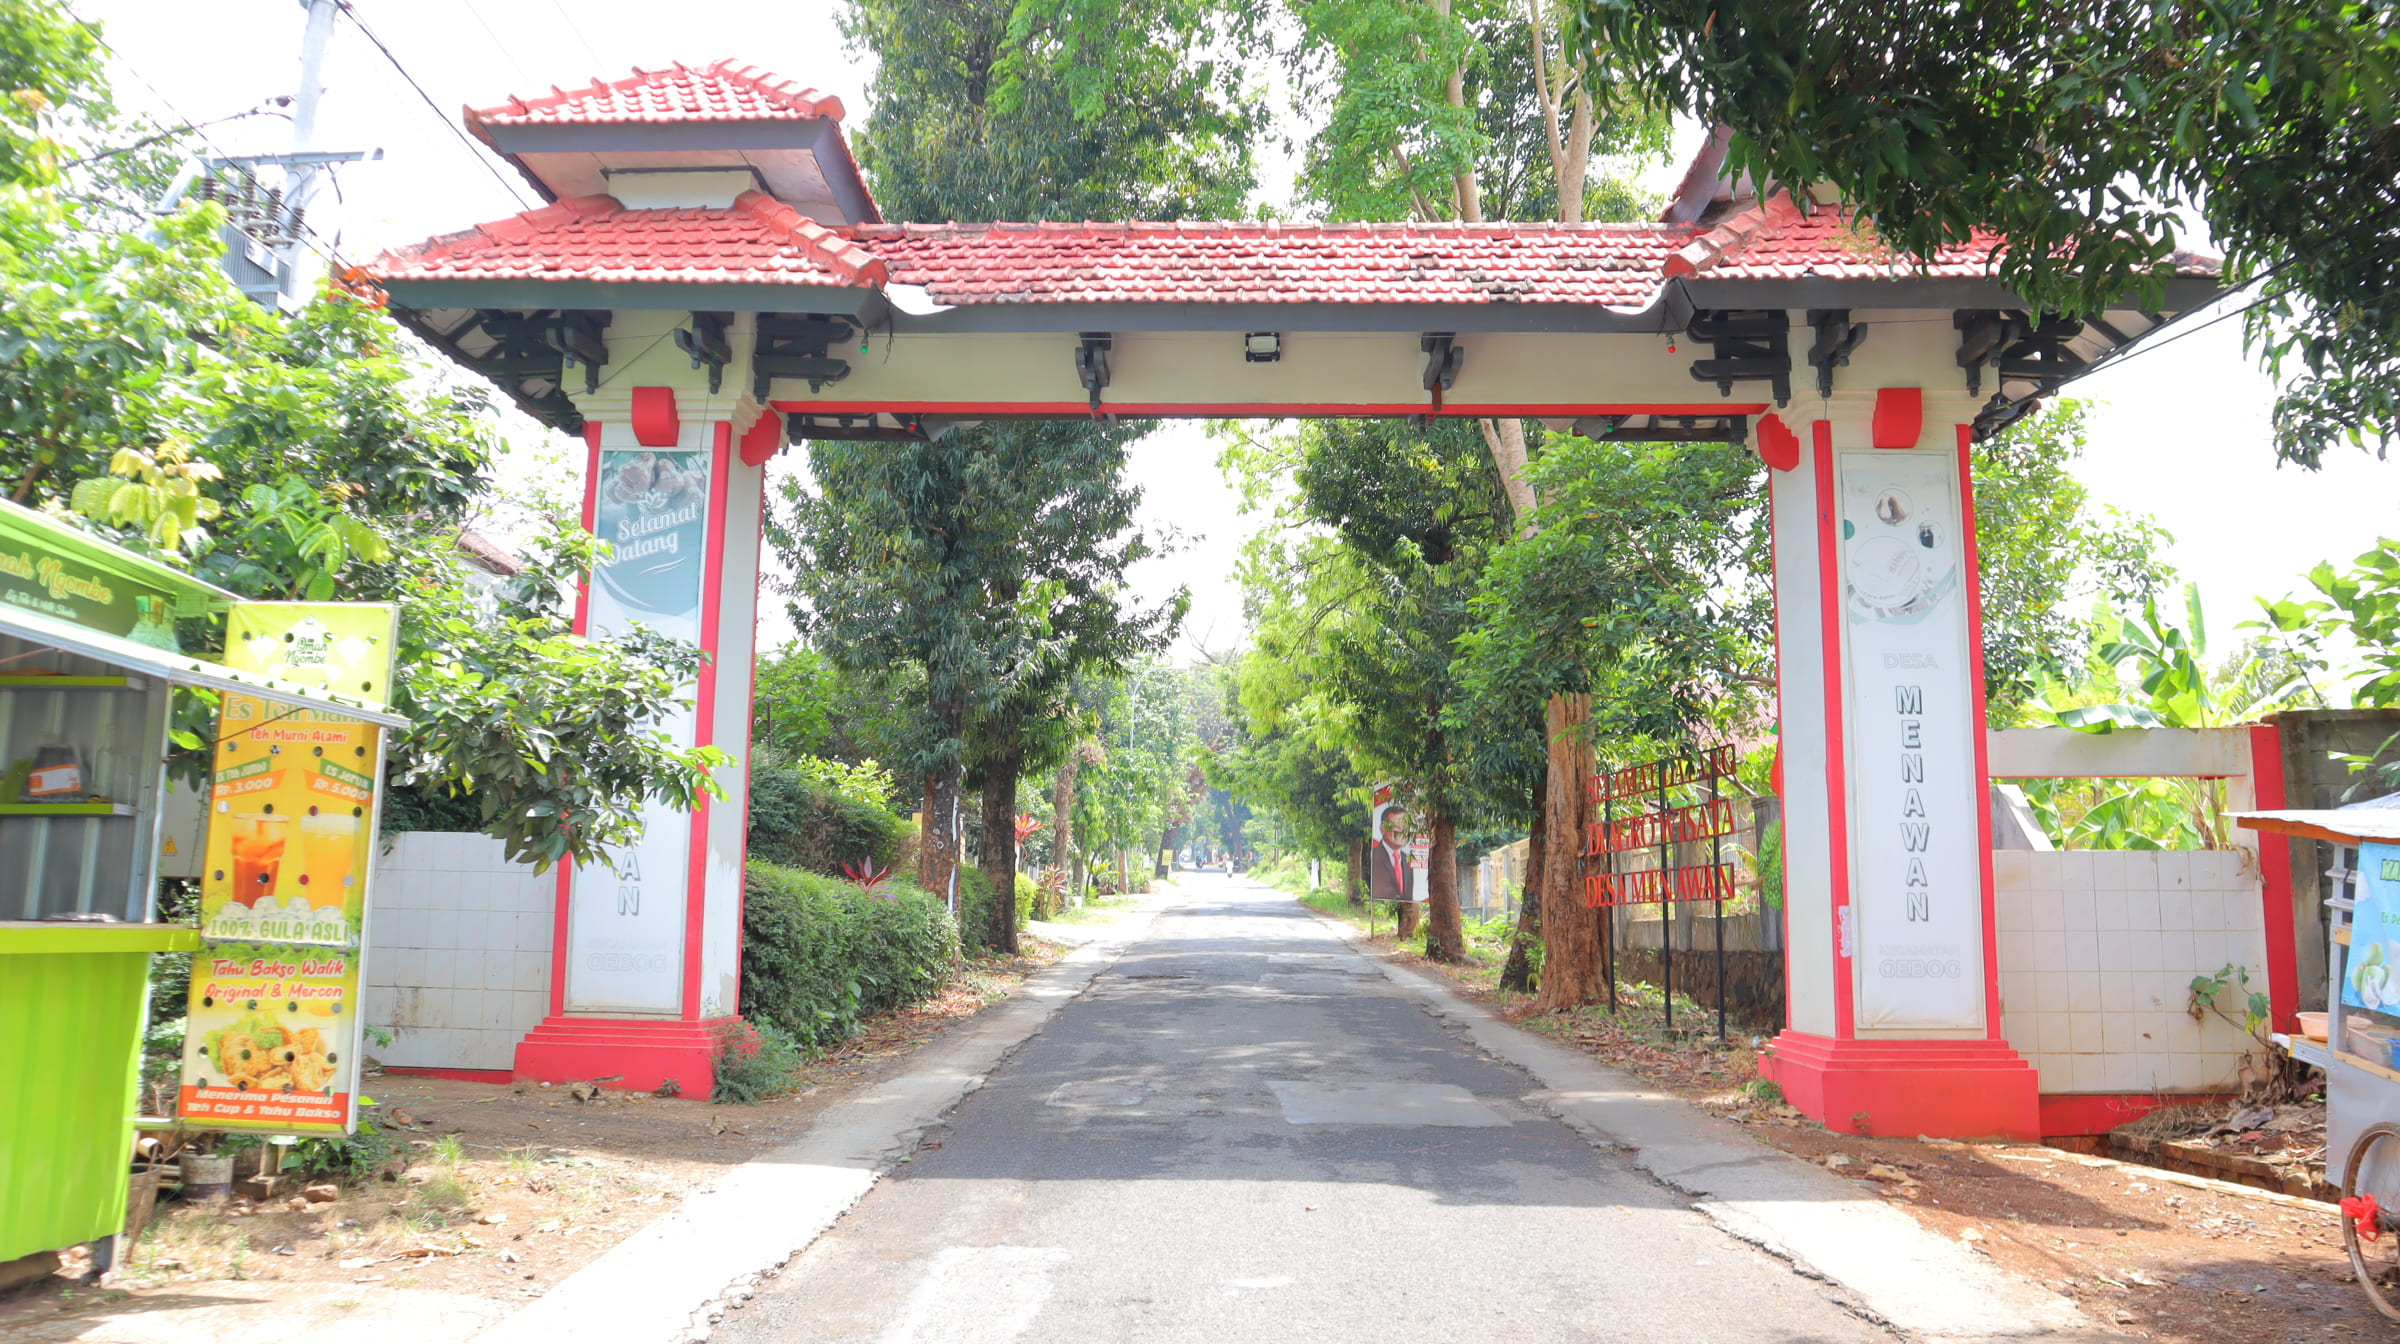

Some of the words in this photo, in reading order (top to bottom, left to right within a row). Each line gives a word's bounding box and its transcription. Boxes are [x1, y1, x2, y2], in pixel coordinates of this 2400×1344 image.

[616, 502, 697, 542] Selamat
[36, 556, 114, 605] Ngombe
[1883, 652, 1939, 670] DESA
[224, 696, 252, 720] Es
[250, 727, 270, 741] Teh
[273, 728, 309, 742] Murni
[1896, 685, 1930, 922] MENAWAN
[1586, 872, 1628, 909] DESA
[210, 920, 253, 937] 100%
[259, 920, 304, 940] GULA
[311, 921, 349, 942] ASLI
[212, 959, 246, 977] Tahu
[250, 958, 296, 979] Bakso
[302, 958, 345, 977] Walik
[205, 982, 268, 1004] Original
[270, 982, 283, 999] &
[288, 982, 344, 999] Mercon
[195, 1088, 268, 1103] Menerima
[271, 1092, 334, 1105] Pesanan
[186, 1102, 210, 1112] Teh
[213, 1103, 241, 1115] Cup
[259, 1105, 292, 1117] Tahu
[295, 1107, 342, 1119] Bakso
